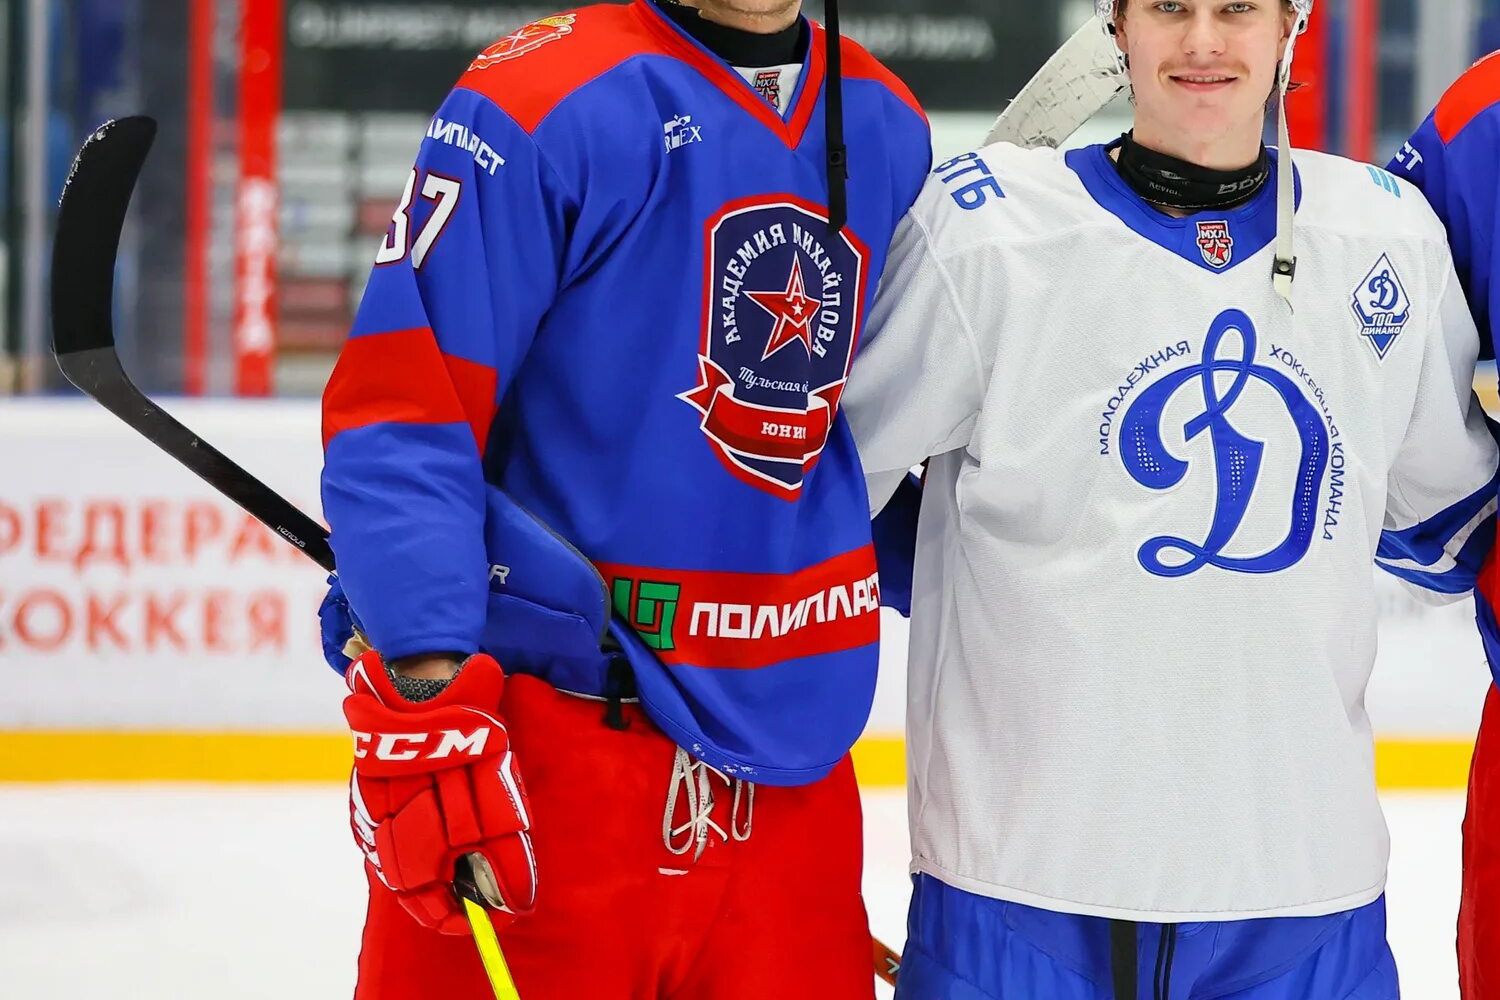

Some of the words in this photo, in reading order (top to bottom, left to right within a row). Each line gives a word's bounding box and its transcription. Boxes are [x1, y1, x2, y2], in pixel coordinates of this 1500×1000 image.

[932, 152, 1006, 211] ВТБ
[375, 168, 462, 270] 37
[1200, 229, 1226, 239] МХЛ
[722, 223, 787, 346] АКАДЕМИЯ
[1362, 326, 1401, 335] ДИНАМО
[1372, 313, 1394, 326] 100
[761, 421, 806, 440] ЮНИ
[1100, 340, 1192, 455] МОЛОДЕЖНАЯ
[1322, 442, 1345, 540] КОМАНДА
[0, 588, 289, 656] ОККЕЯ
[351, 727, 490, 761] CCM
